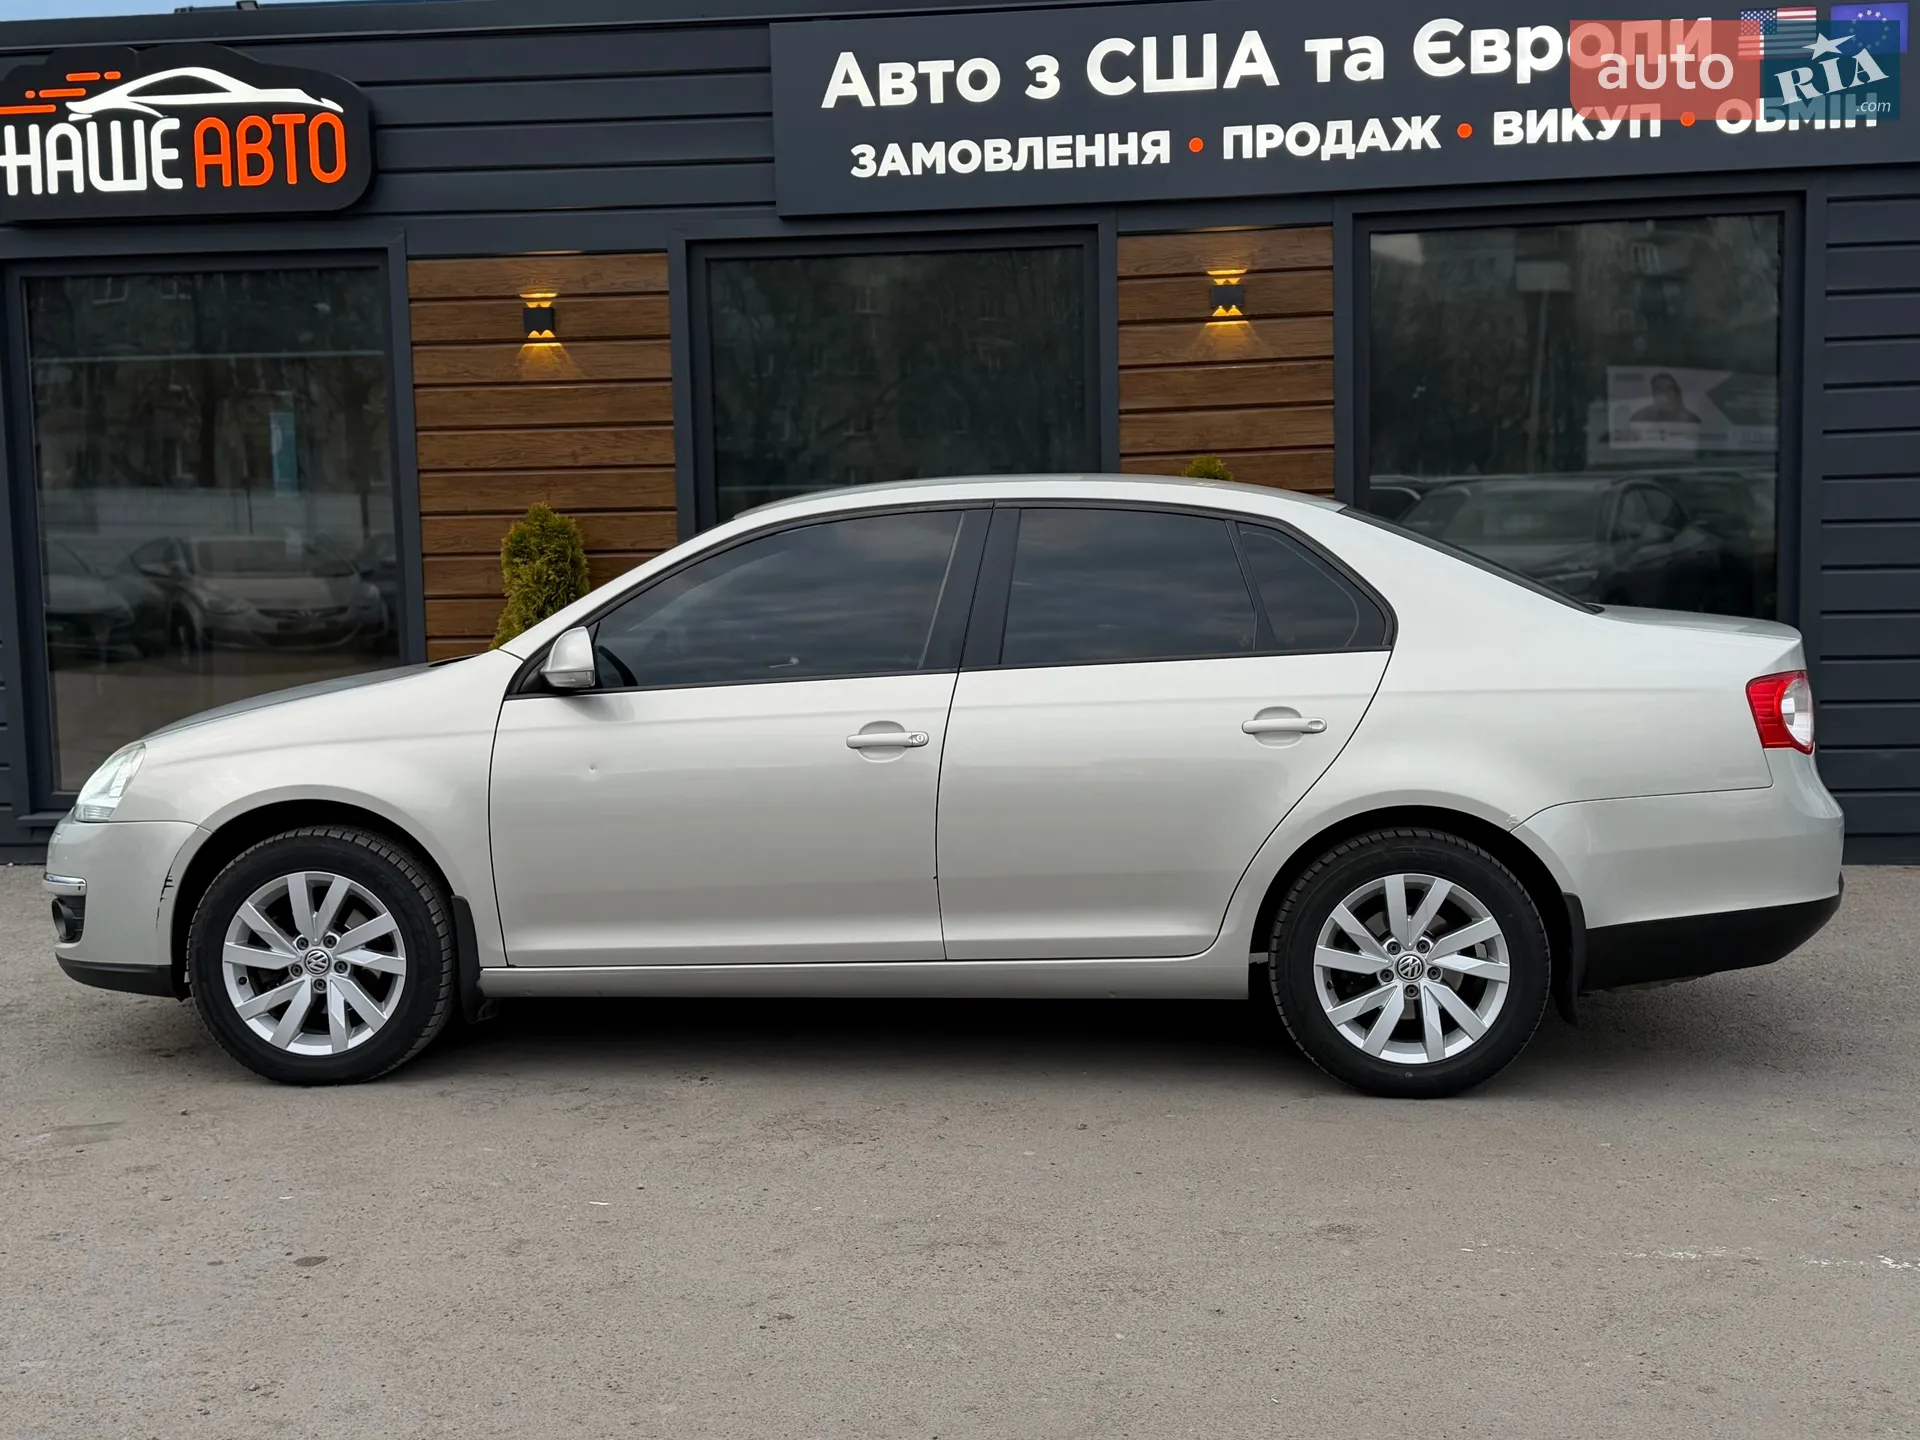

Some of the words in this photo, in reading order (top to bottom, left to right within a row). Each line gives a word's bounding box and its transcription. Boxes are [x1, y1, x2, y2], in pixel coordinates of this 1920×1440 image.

[820, 51, 1001, 109] Авто
[1024, 54, 1061, 100] з
[1086, 30, 1281, 96] США
[1304, 35, 1385, 83] та
[1412, 17, 1713, 85] Європи
[0, 117, 184, 196] НАШЕ
[193, 111, 347, 188] АВТО
[849, 130, 1172, 178] ЗАМОВЛЕННЯ
[1222, 114, 1442, 162] ПРОДАЖ
[1493, 103, 1662, 146] ВИКУП
[1715, 92, 1878, 134] ОБМІН
